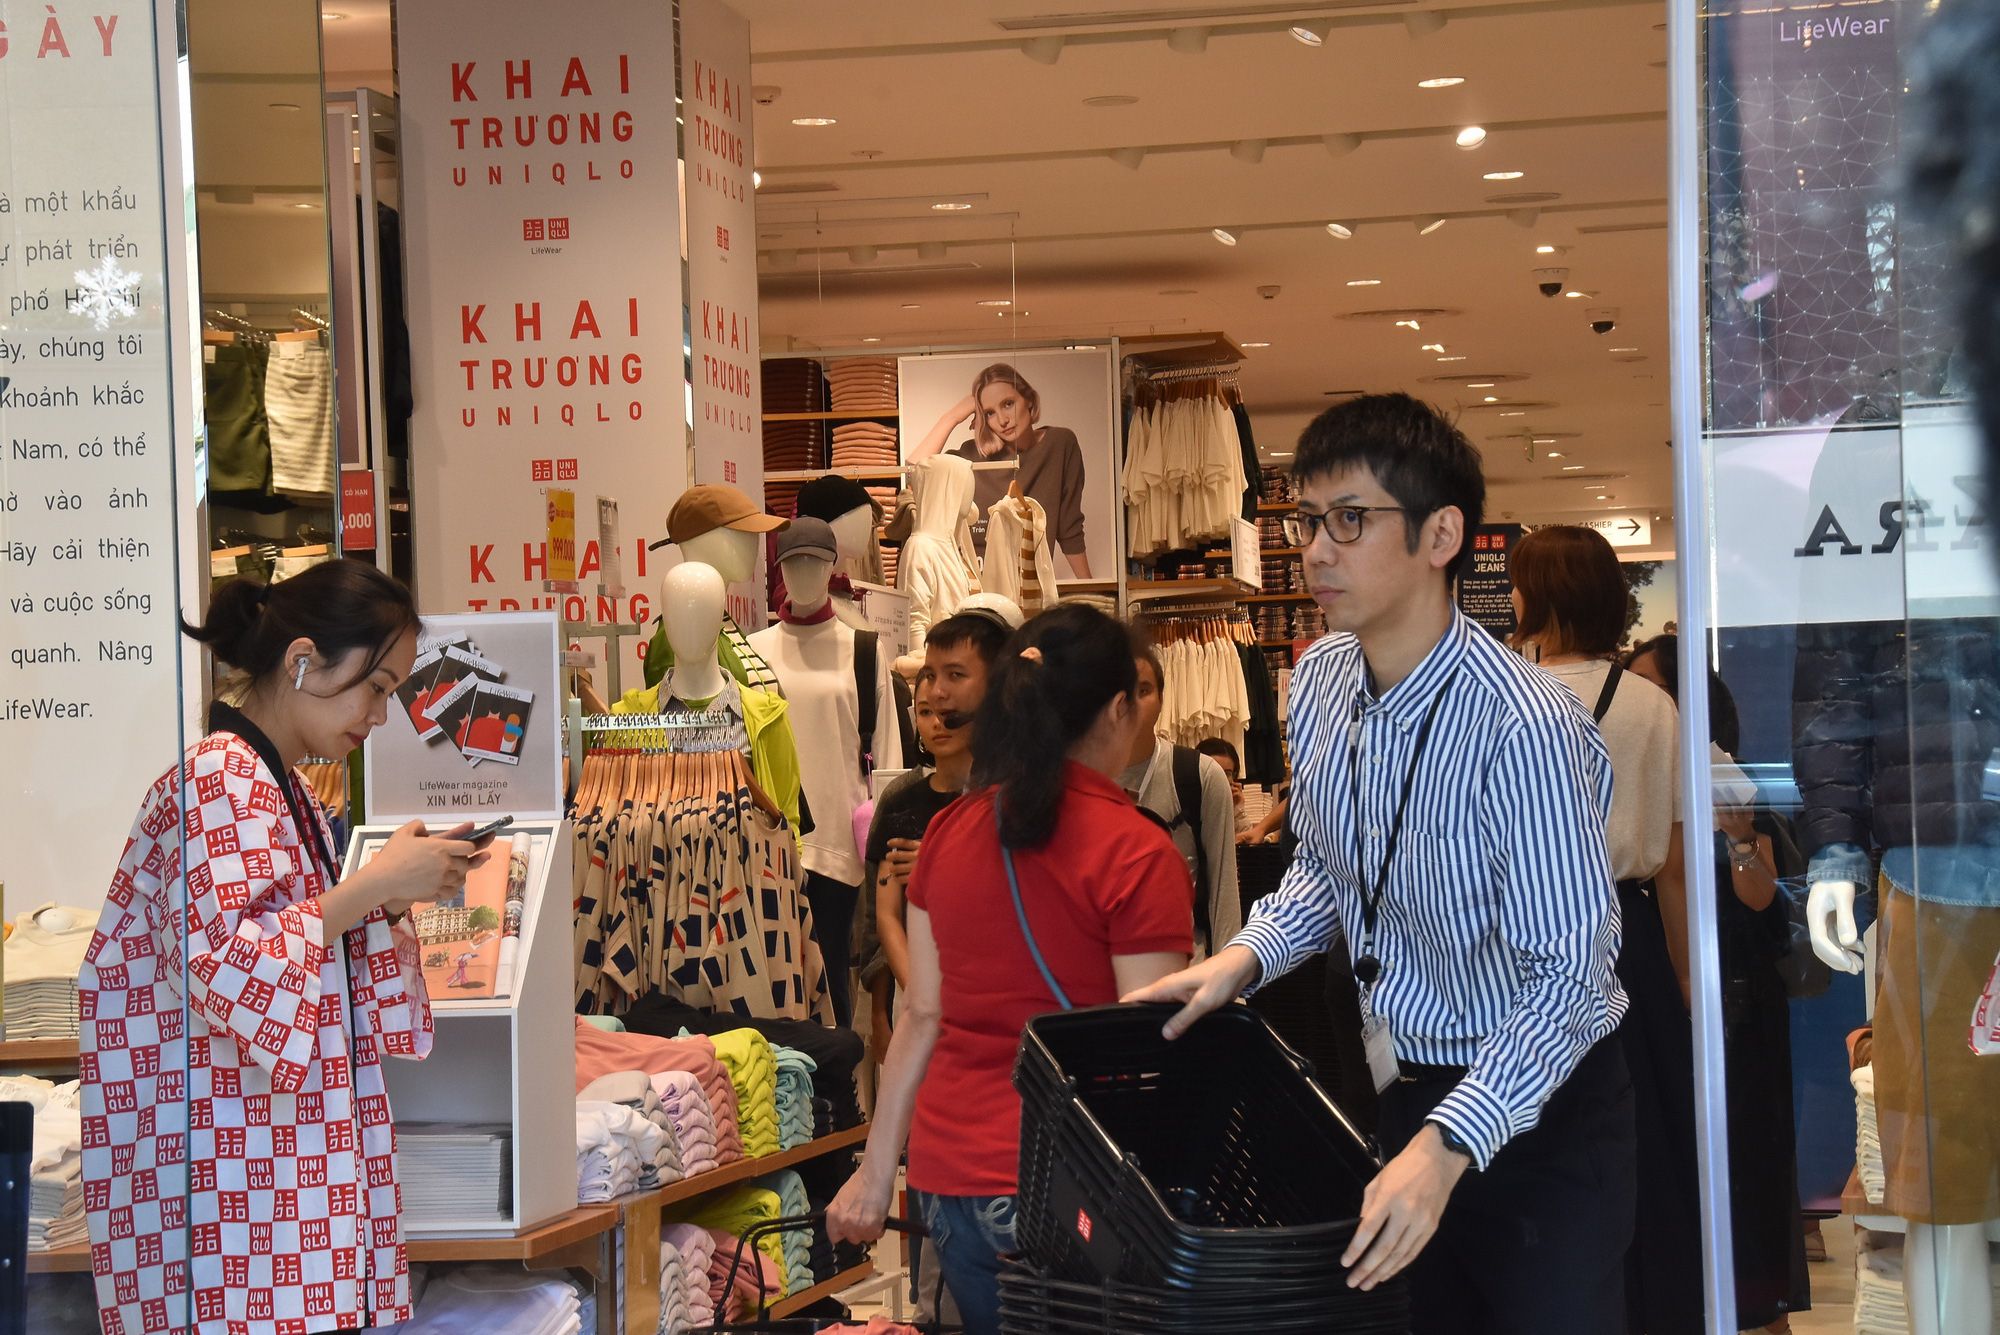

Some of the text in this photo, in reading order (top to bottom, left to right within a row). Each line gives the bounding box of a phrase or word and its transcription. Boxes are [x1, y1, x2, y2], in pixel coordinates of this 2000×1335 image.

[1781, 16, 1889, 41] LifeWear
[453, 55, 628, 102] KHAI
[694, 59, 742, 123] KHAI
[451, 112, 632, 149] TRƯƠNG
[454, 160, 633, 185] UNIQLO
[697, 162, 744, 203] UNIQLO
[26, 191, 67, 216] một
[83, 186, 135, 210] khẩu
[26, 239, 72, 266] phát
[531, 247, 562, 255] LifeWear
[11, 288, 48, 316] phố
[462, 298, 638, 343] KHAI
[703, 299, 749, 354] KHAI
[40, 336, 104, 361] chúng
[118, 334, 142, 355] tôi
[461, 353, 642, 390] TRƯƠNG
[93, 380, 143, 405] khắc
[463, 401, 642, 427] UNIQLO
[705, 401, 751, 434] UNIQLO
[13, 432, 146, 460] Nam, có thể
[45, 490, 81, 510] vào
[109, 487, 147, 508] ảnh
[343, 512, 372, 529] .000
[53, 539, 82, 559] cải
[98, 538, 149, 562] thiện
[469, 538, 647, 584] KHAI
[1474, 553, 1506, 562] UNIQLO
[1474, 563, 1506, 572] JEANS
[11, 587, 150, 616] và cuộc sống
[12, 641, 152, 669] quanh. Nâng
[420, 780, 508, 790] LifeWear magazine
[427, 796, 446, 806] XIN
[234, 938, 257, 958] UNI
[228, 951, 253, 969] QLO
[99, 967, 122, 978] UNI
[287, 964, 304, 978] UNI
[103, 976, 127, 989] QLO
[281, 975, 303, 991] QLO
[160, 1012, 183, 1026] UNI
[99, 1022, 121, 1034] UNI
[161, 1023, 183, 1040] QLO
[263, 1022, 286, 1039] UNI
[99, 1035, 125, 1049] QLO
[257, 1034, 282, 1051] QLO
[159, 1074, 182, 1087] UNI
[106, 1084, 130, 1097] UNI
[109, 1097, 134, 1111] QLO
[247, 1098, 267, 1109] UNI
[299, 1096, 320, 1108] UNI
[361, 1099, 382, 1111] UNI
[248, 1111, 268, 1124] QLO
[299, 1108, 322, 1122] QLO
[363, 1110, 386, 1125] QLO
[157, 1135, 184, 1150] UNI
[115, 1147, 132, 1160] UNI
[115, 1160, 132, 1175] QLO
[249, 1162, 270, 1174] UNI
[300, 1159, 322, 1171] UNI
[369, 1159, 388, 1171] UNI
[250, 1175, 272, 1188] QLO
[300, 1172, 324, 1186] QLO
[370, 1171, 391, 1185] QLO
[112, 1210, 128, 1223] UNI
[111, 1223, 132, 1238] QLO
[253, 1227, 270, 1238] UNI
[303, 1222, 325, 1235] UNI
[375, 1220, 394, 1232] UNI
[303, 1235, 327, 1249] QLO
[376, 1232, 397, 1246] QLO
[253, 1240, 270, 1253] QLO
[116, 1275, 134, 1288] UNI
[379, 1282, 394, 1293] UNI
[119, 1288, 137, 1303] QLO
[250, 1292, 268, 1303] UNI
[307, 1286, 329, 1299] UNI
[307, 1299, 332, 1314] QLO
[379, 1294, 394, 1308] QLO
[249, 1305, 271, 1318] QLO
